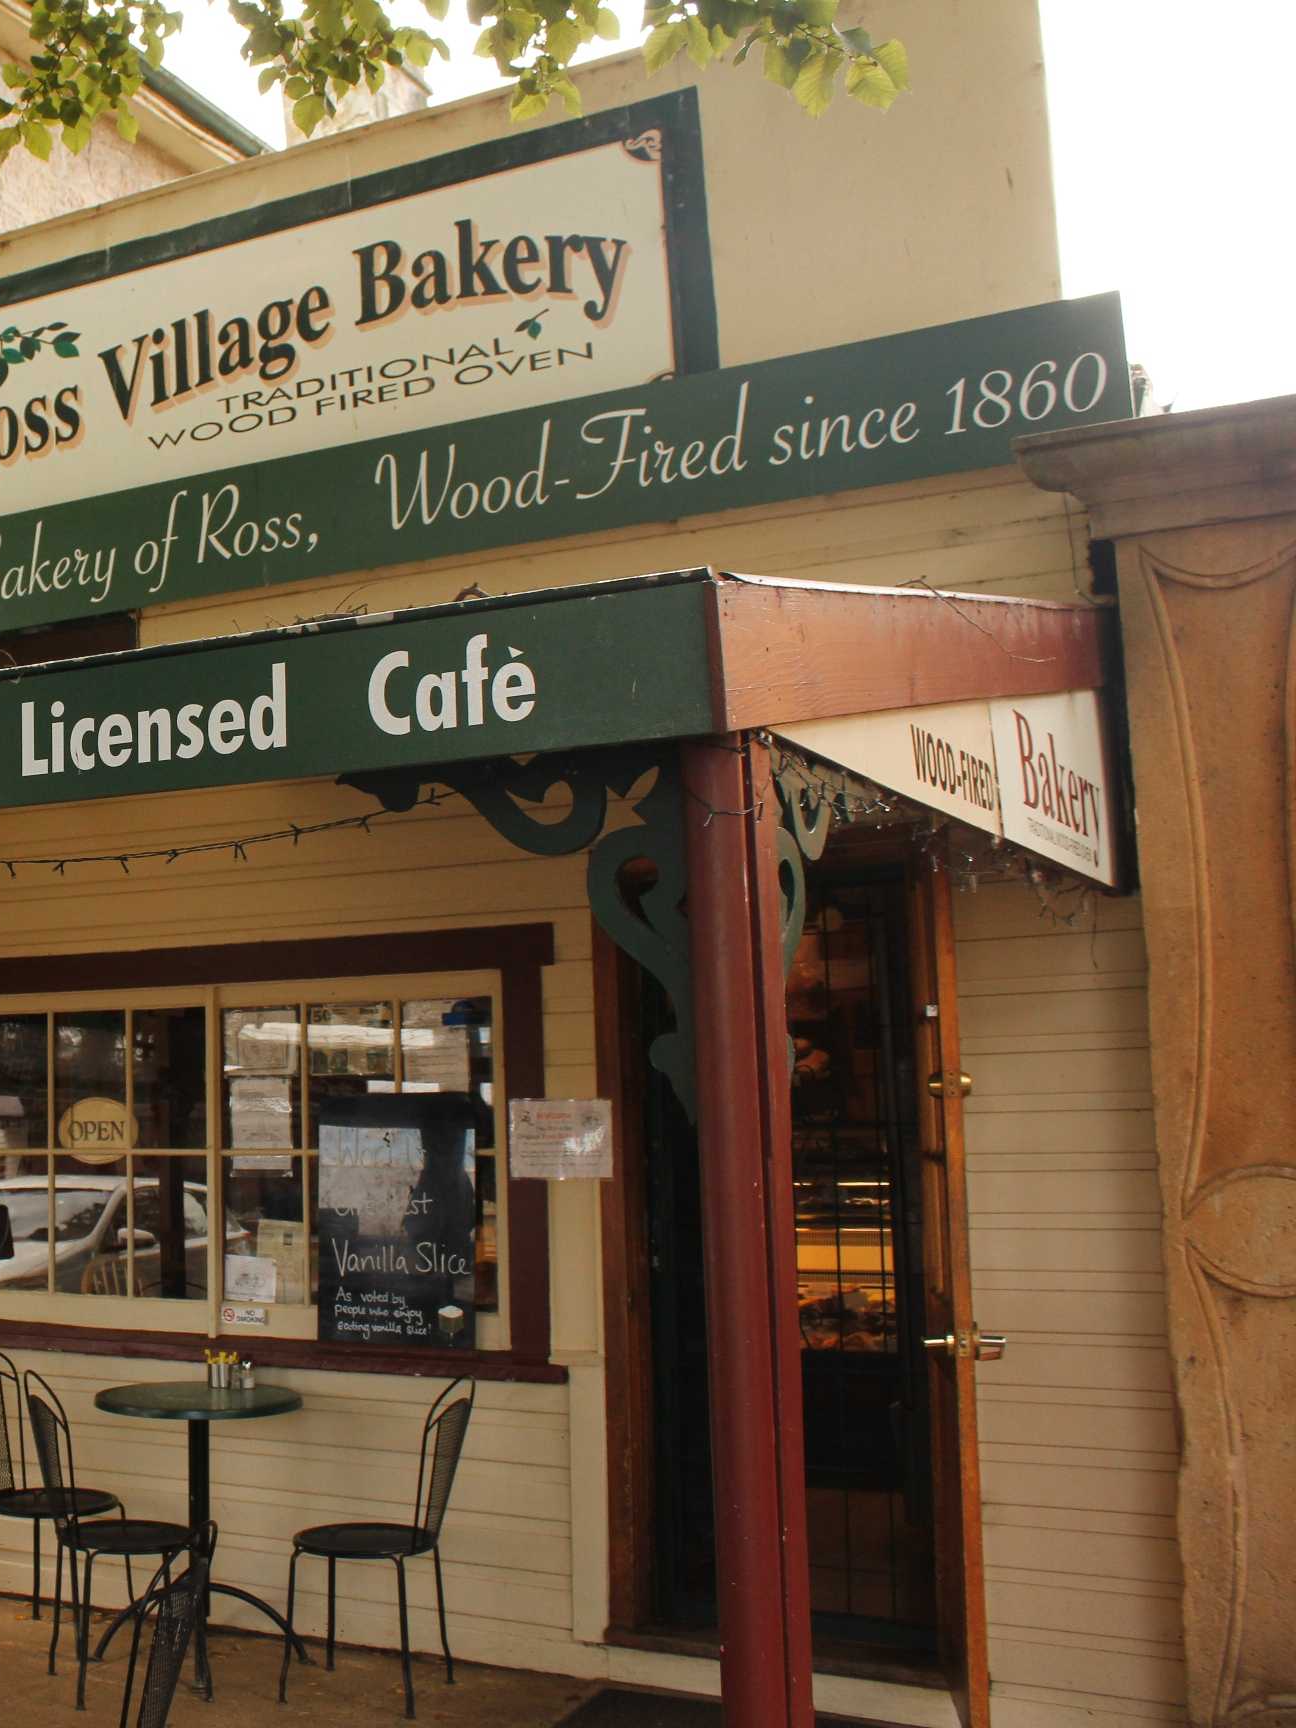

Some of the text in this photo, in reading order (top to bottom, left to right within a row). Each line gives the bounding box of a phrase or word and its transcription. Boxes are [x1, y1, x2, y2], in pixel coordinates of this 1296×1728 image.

[98, 282, 336, 424] Village
[352, 219, 630, 329] Bakery
[148, 341, 594, 450] WOOD FIRED OVEN
[218, 337, 514, 415] TRADITIONAL
[134, 490, 189, 594] of
[196, 482, 320, 565] Ross,
[373, 380, 751, 531] Wood-Fired
[768, 395, 918, 466] since
[942, 351, 1109, 437] 1860
[20, 661, 288, 778] Licensed
[909, 723, 995, 811] WOOD-FIRED
[1012, 708, 1101, 868] Bakery
[68, 1120, 126, 1142] OPEN
[331, 1237, 472, 1278] Vanilla Slice
[335, 1285, 409, 1310] As voted by
[334, 1303, 424, 1326] people who enjoy
[336, 1320, 371, 1341] eating
[371, 1321, 403, 1335] vanilla
